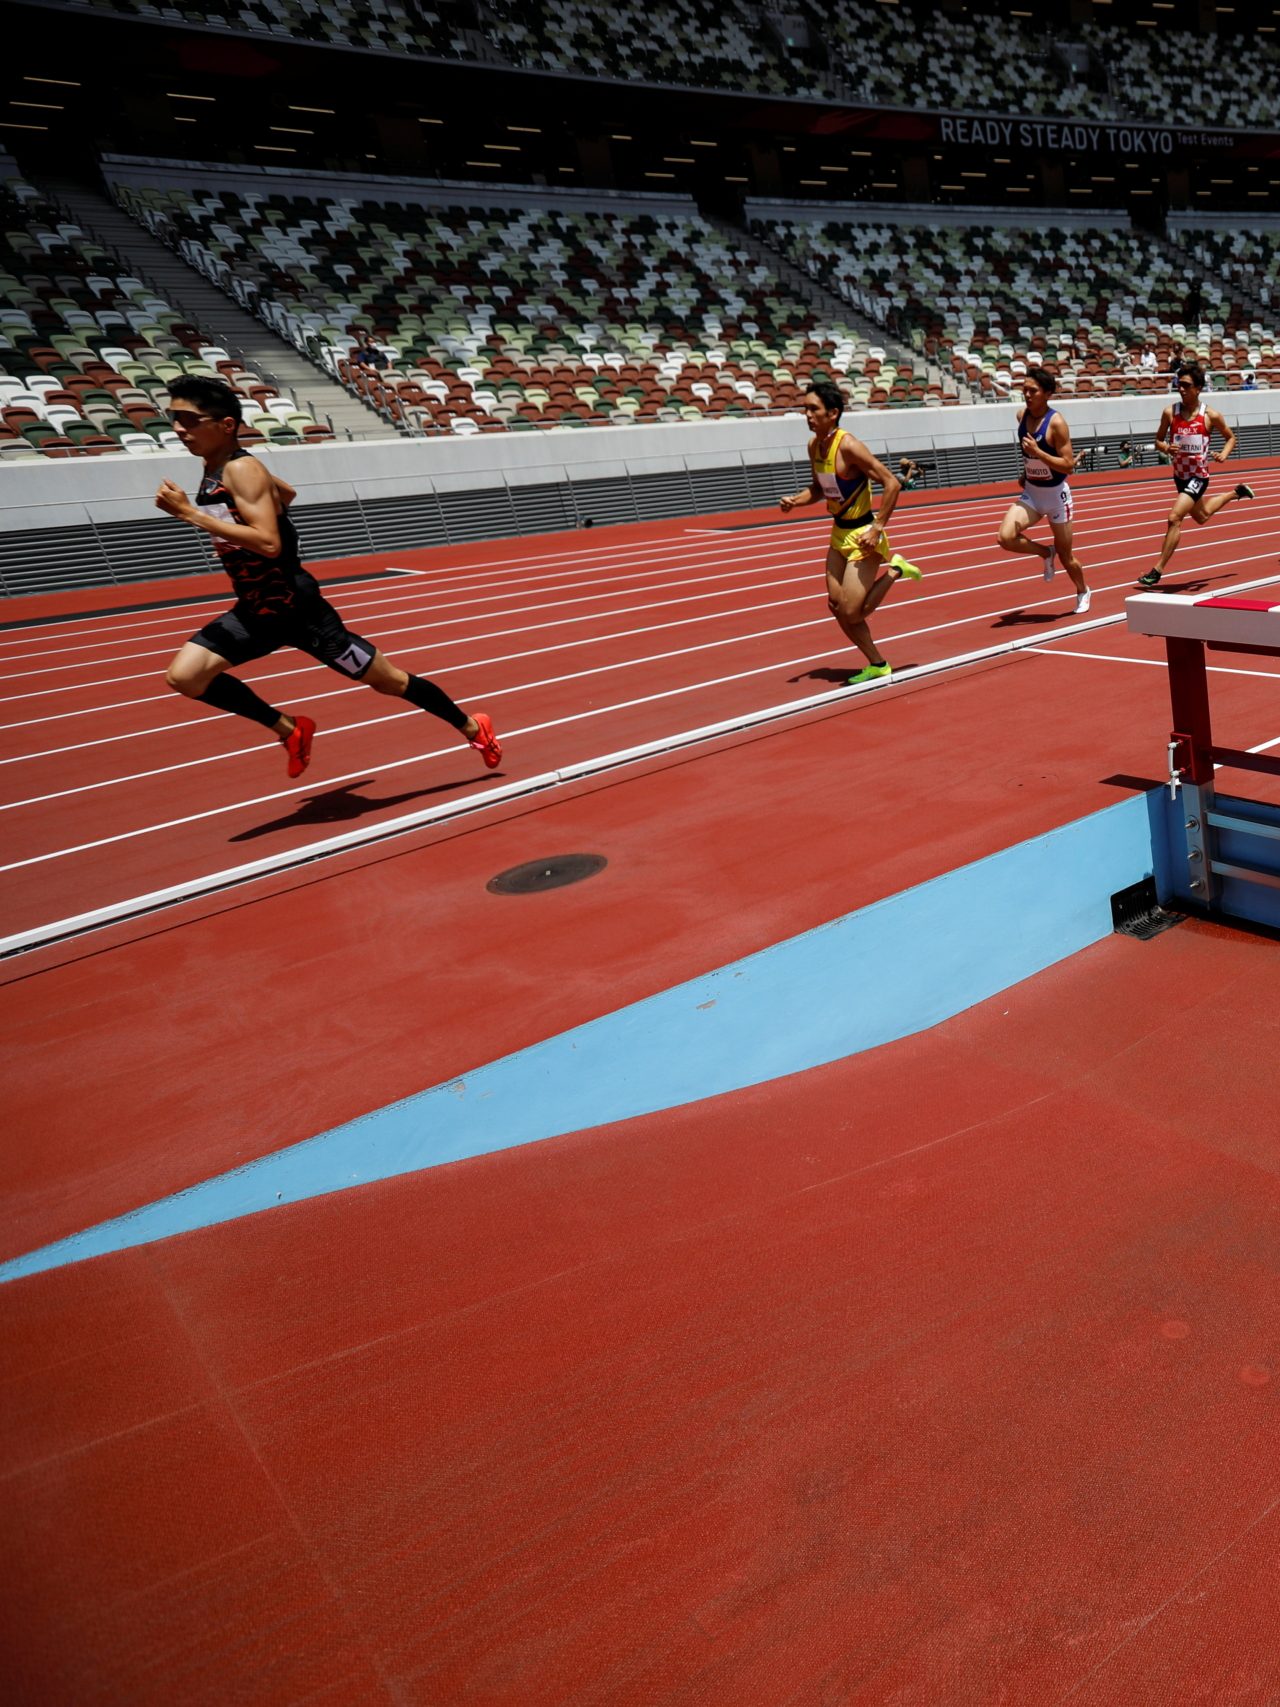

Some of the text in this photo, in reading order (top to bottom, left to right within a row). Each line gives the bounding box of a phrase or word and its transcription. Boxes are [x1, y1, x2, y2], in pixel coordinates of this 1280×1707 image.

[940, 117, 1235, 154] READY STEADY TOKYO Test Events
[1060, 491, 1068, 503] 9
[341, 649, 363, 669] 7
